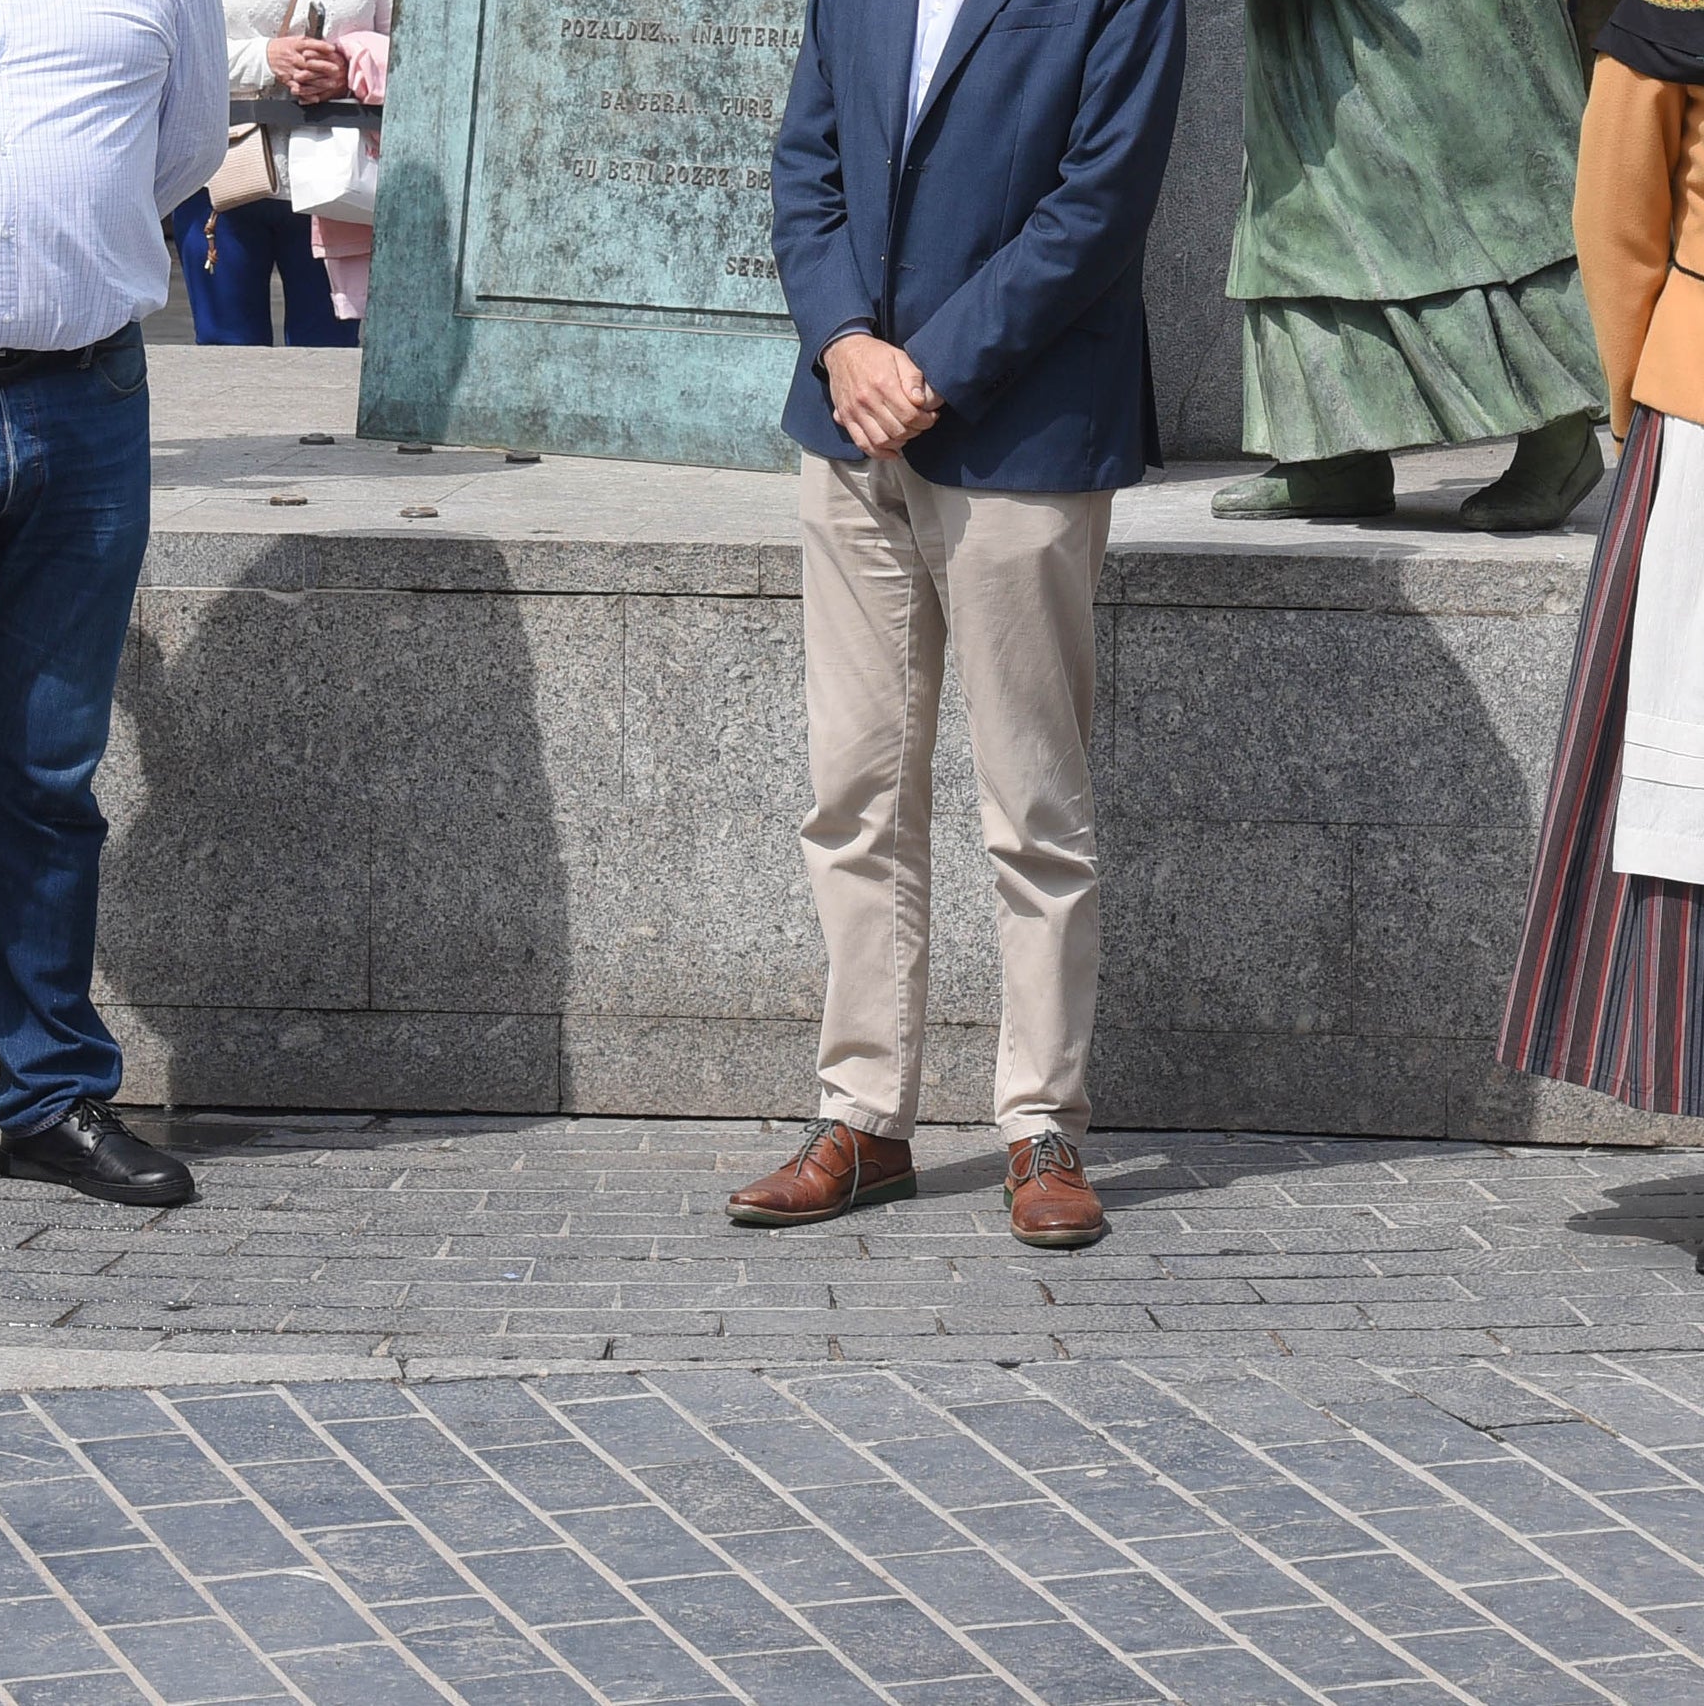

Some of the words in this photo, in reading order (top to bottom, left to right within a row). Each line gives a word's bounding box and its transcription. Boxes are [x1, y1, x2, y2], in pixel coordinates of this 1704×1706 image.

[601, 91, 626, 111] BA
[720, 96, 773, 118] GURE
[572, 159, 596, 179] GU
[607, 161, 654, 181] BETI
[746, 170, 771, 190] BE
[726, 257, 778, 279] SERA
